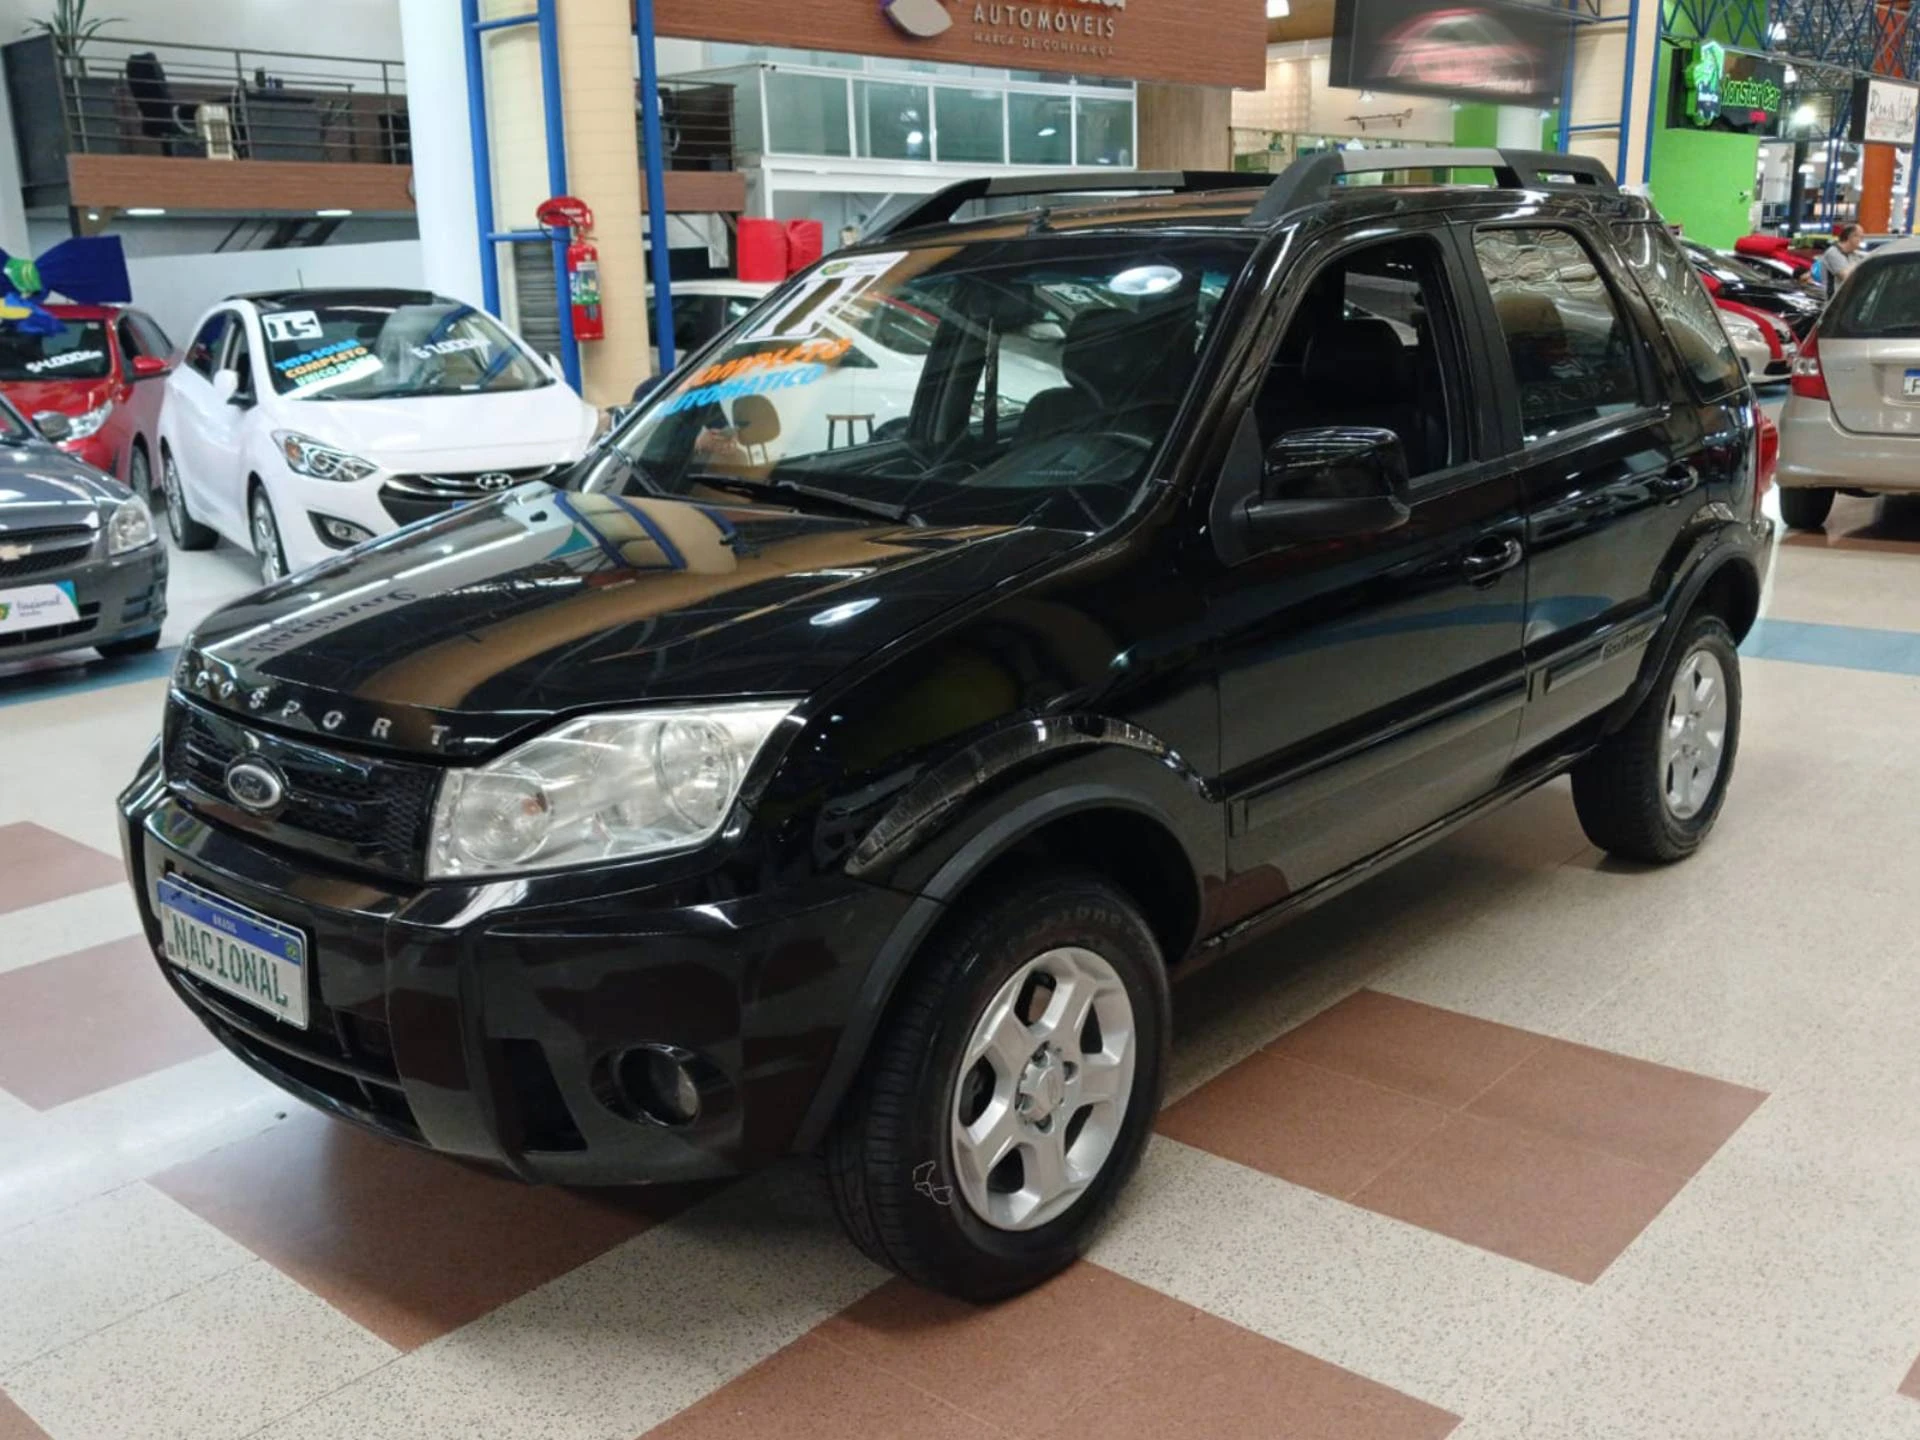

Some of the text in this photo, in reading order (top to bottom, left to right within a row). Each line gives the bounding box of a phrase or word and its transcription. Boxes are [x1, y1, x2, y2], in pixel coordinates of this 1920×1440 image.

[973, 3, 1115, 38] AUTOMÓVEIS
[266, 315, 319, 340] 15
[285, 346, 369, 379] COMPLETO
[178, 660, 450, 746] ECOSPORT
[172, 912, 288, 1008] NACIONAL
